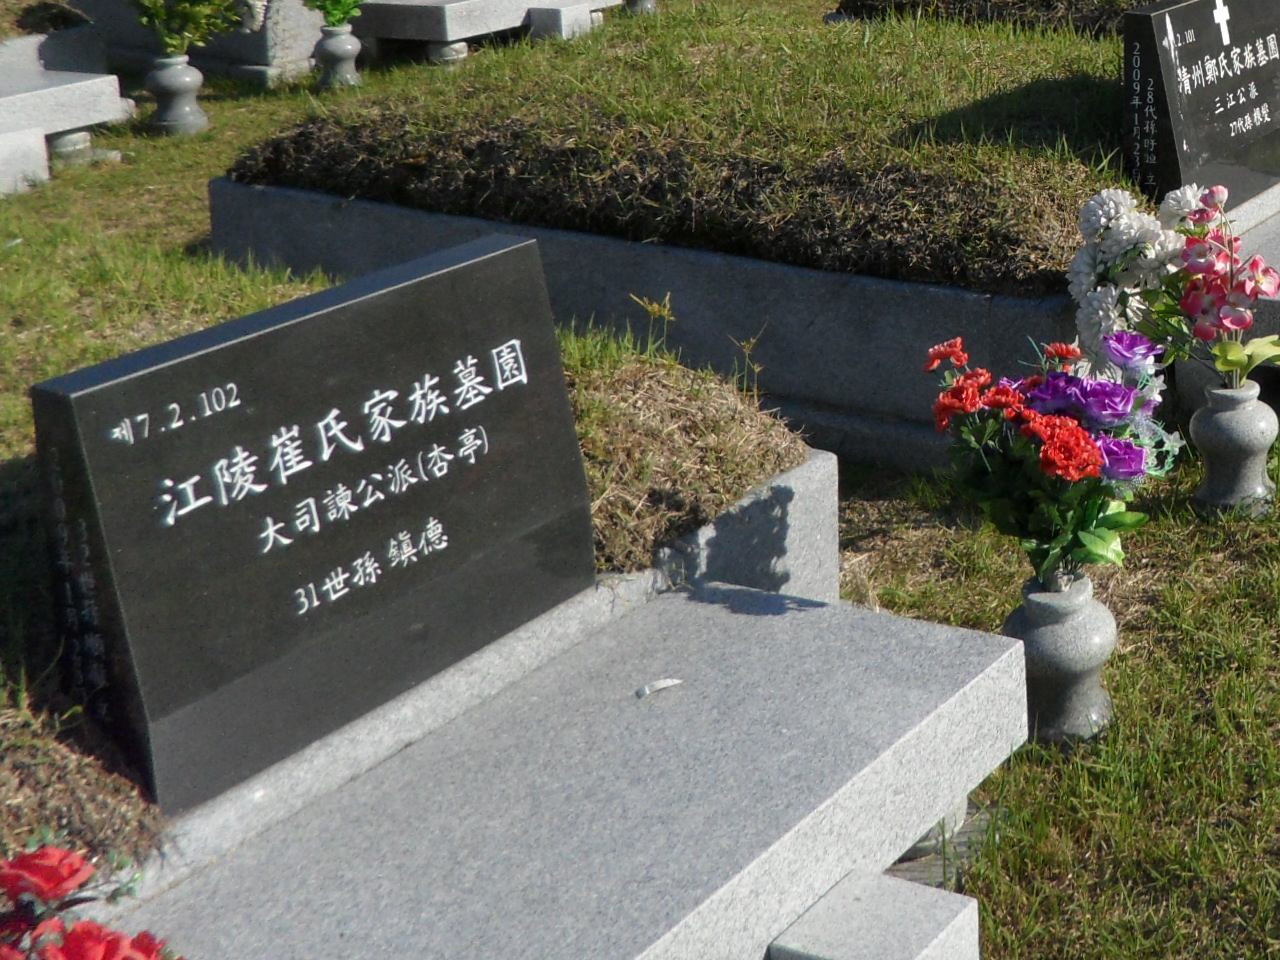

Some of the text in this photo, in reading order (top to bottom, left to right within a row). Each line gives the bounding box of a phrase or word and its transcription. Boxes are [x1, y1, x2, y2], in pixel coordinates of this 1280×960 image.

[160, 338, 529, 527] 江陵崔氏家族墓園
